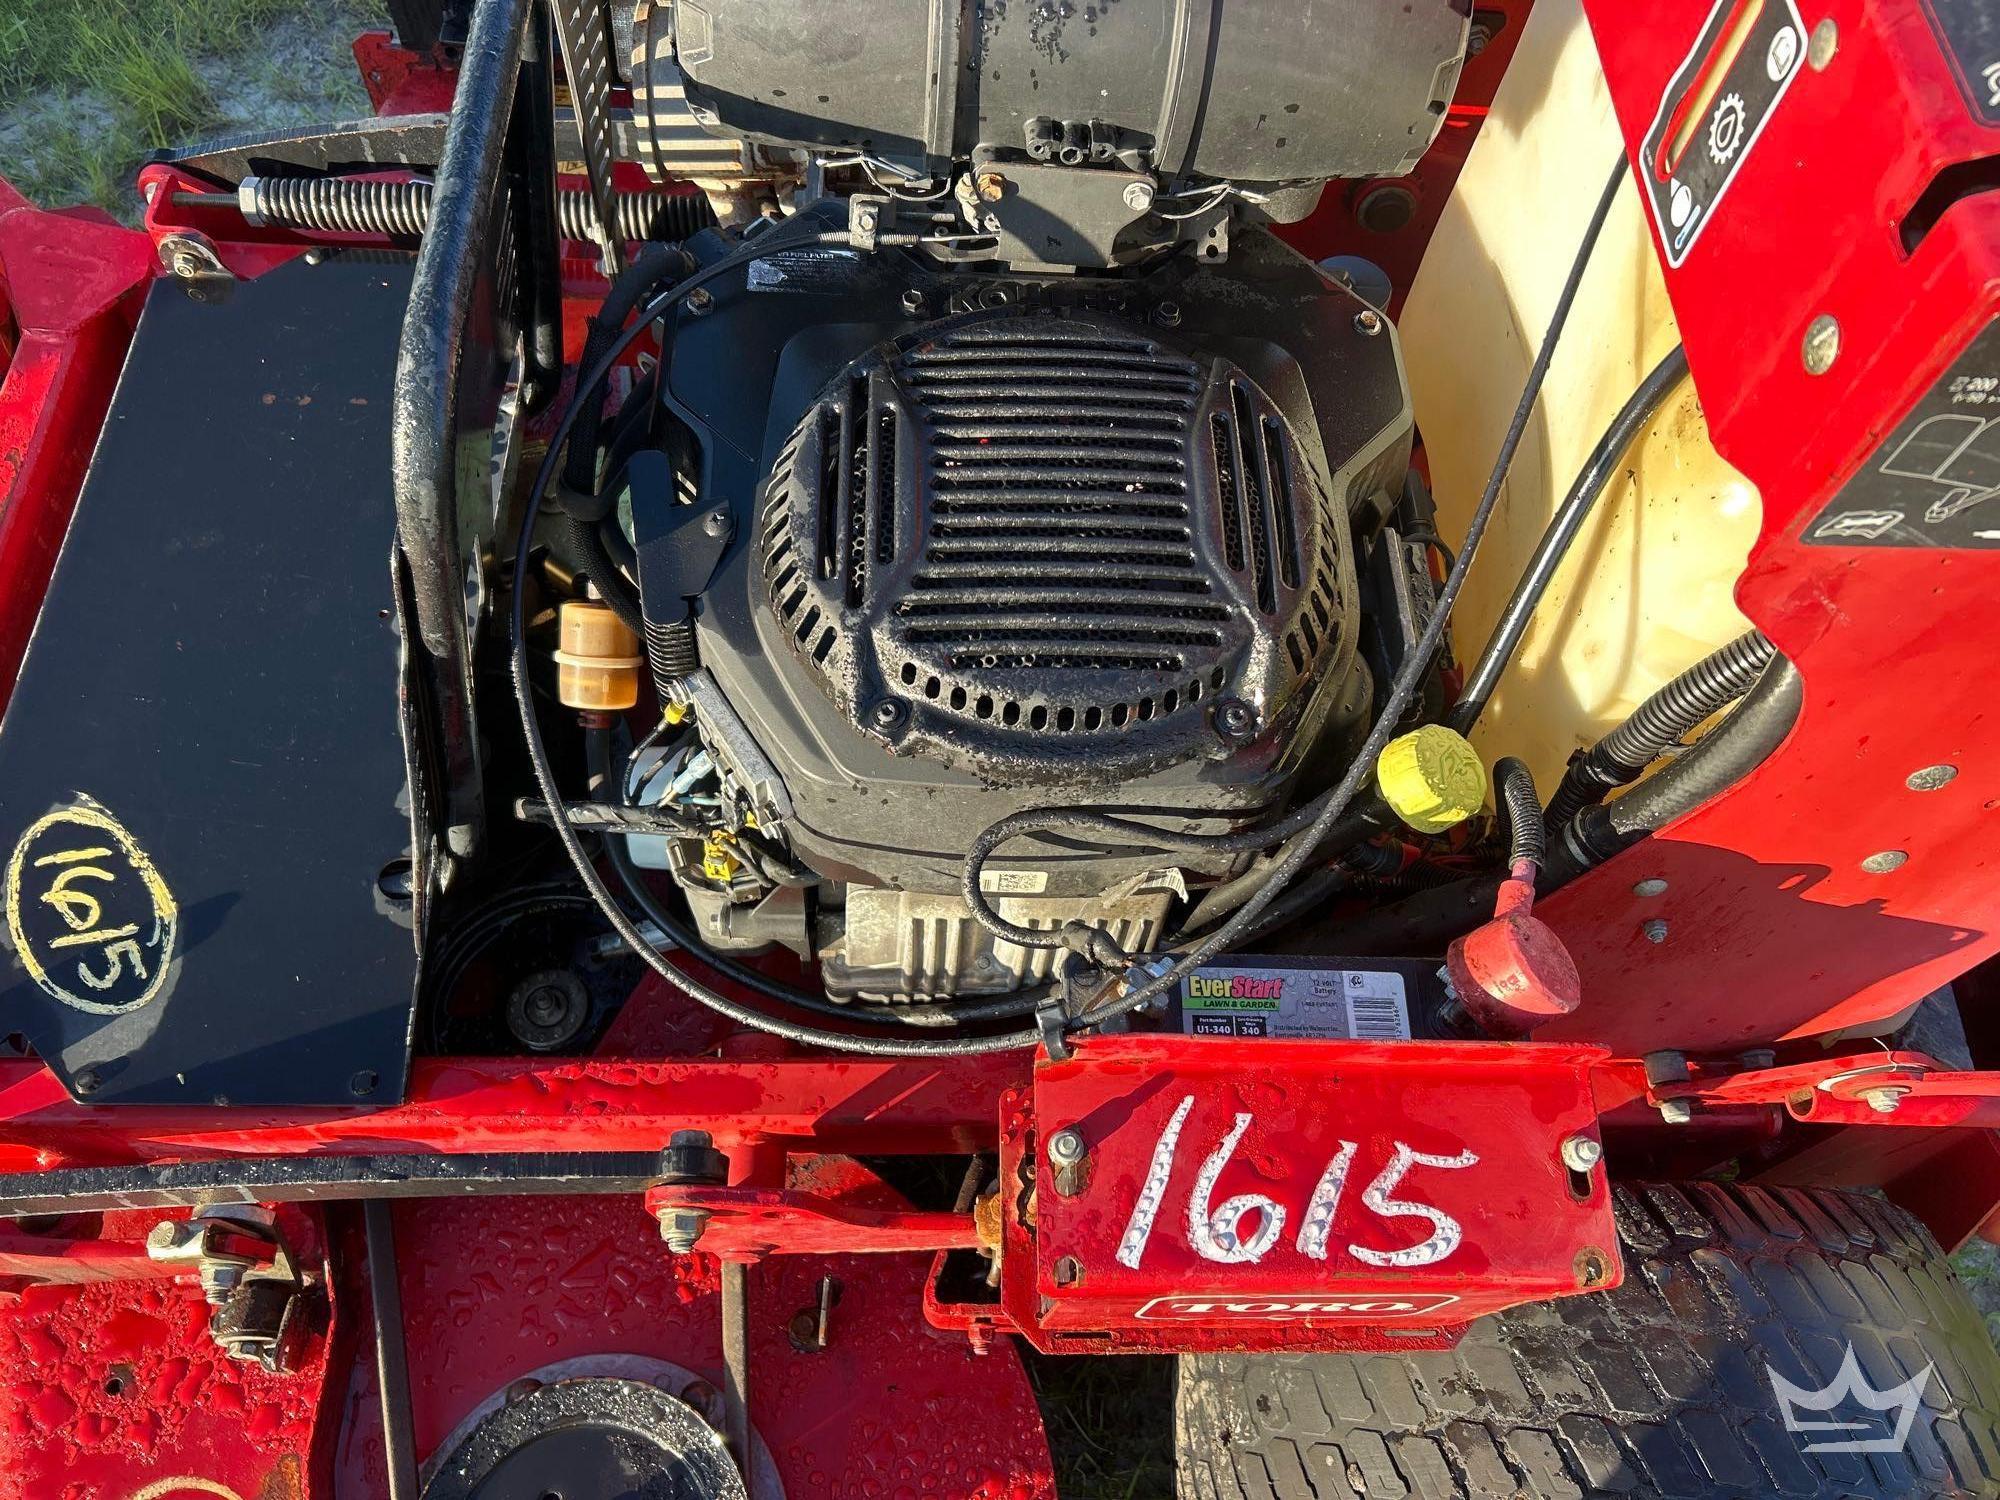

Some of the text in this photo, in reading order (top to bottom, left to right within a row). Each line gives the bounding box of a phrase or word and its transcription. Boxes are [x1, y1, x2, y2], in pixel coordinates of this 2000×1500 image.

[34, 848, 148, 990] 1615
[1189, 975, 1283, 999] EverStart
[1314, 987, 1336, 995] Battery
[1197, 1025, 1231, 1034] U1-340
[1241, 1027, 1260, 1035] 340
[1115, 1095, 1480, 1270] 1615
[1171, 1302, 1415, 1313] TORO
